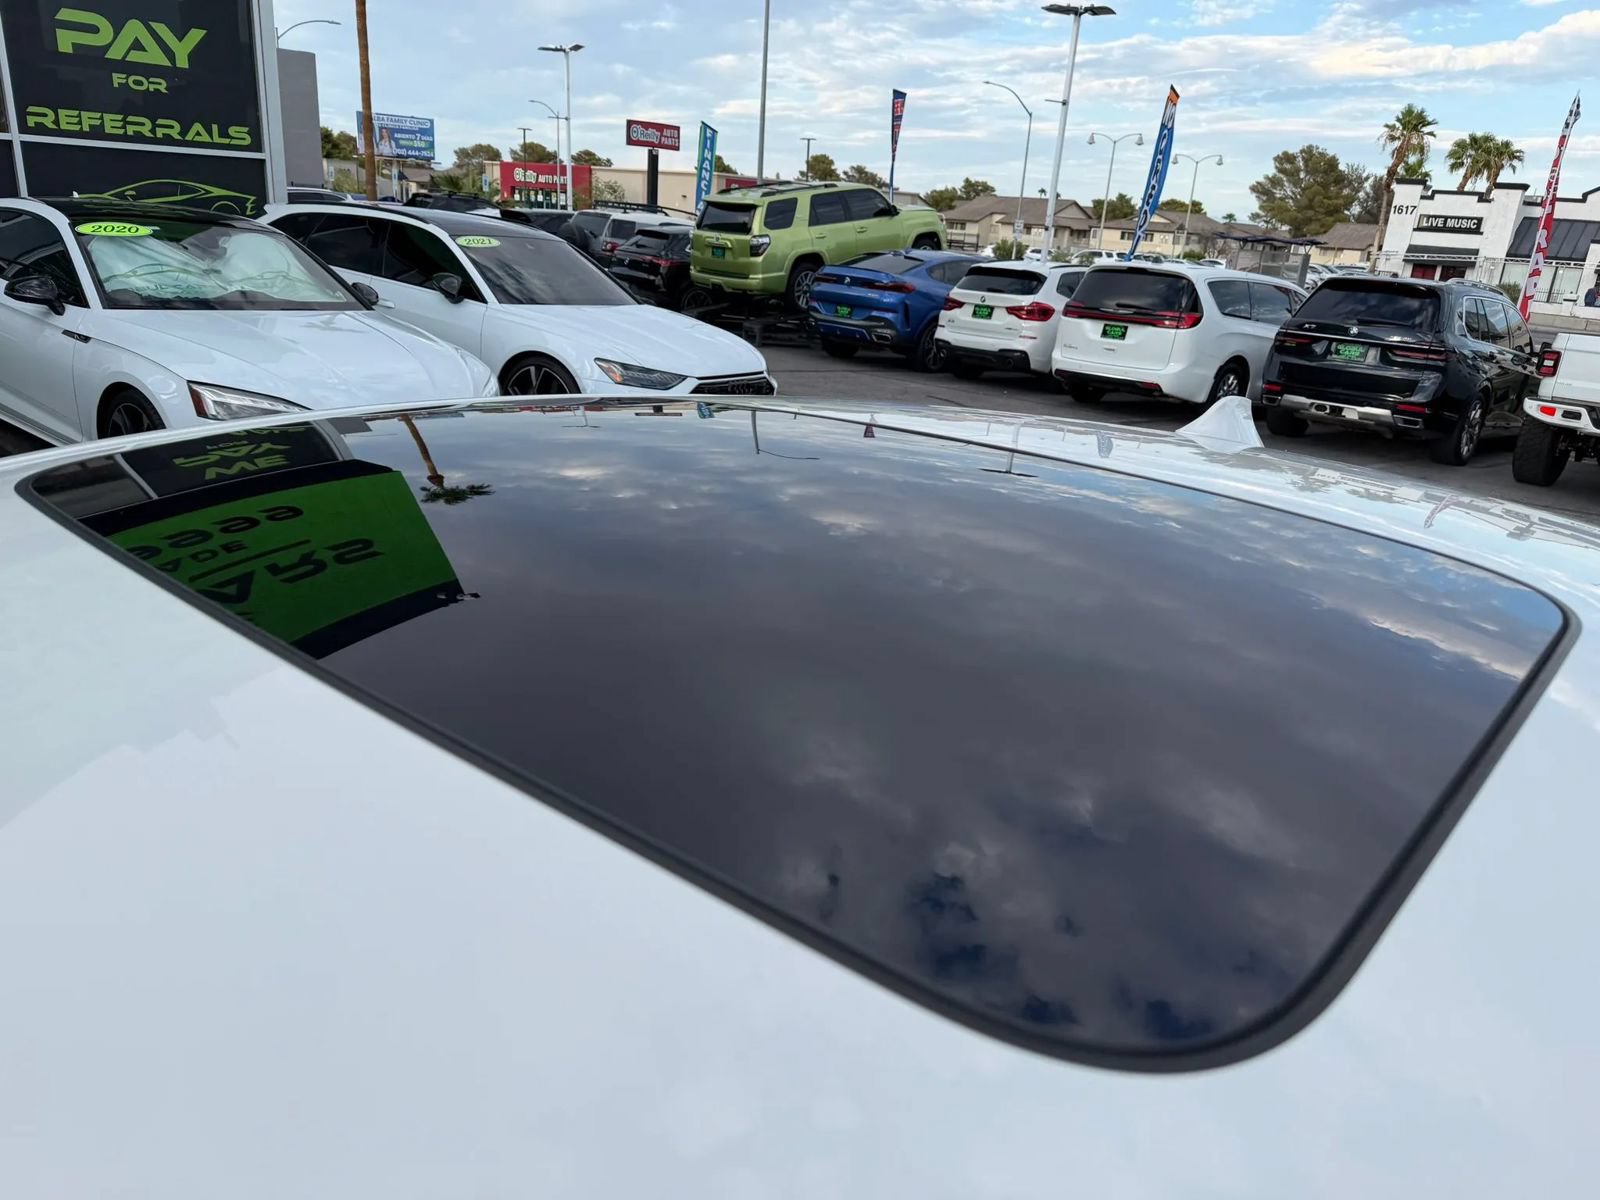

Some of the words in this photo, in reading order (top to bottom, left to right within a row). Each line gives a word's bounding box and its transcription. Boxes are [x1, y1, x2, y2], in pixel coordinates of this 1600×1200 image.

[54, 7, 208, 69] PAY
[111, 72, 168, 93] FOR
[25, 105, 252, 146] REFERRALS
[408, 119, 430, 128] CLINIC
[630, 124, 660, 144] O'Reilly
[663, 128, 678, 137] AUTO
[661, 137, 679, 147] PARTS
[538, 175, 552, 184] AUTO
[1392, 205, 1417, 215] 1617
[1423, 216, 1444, 227] LIVE
[1446, 218, 1478, 229] MUSIC
[90, 225, 139, 233] 2020
